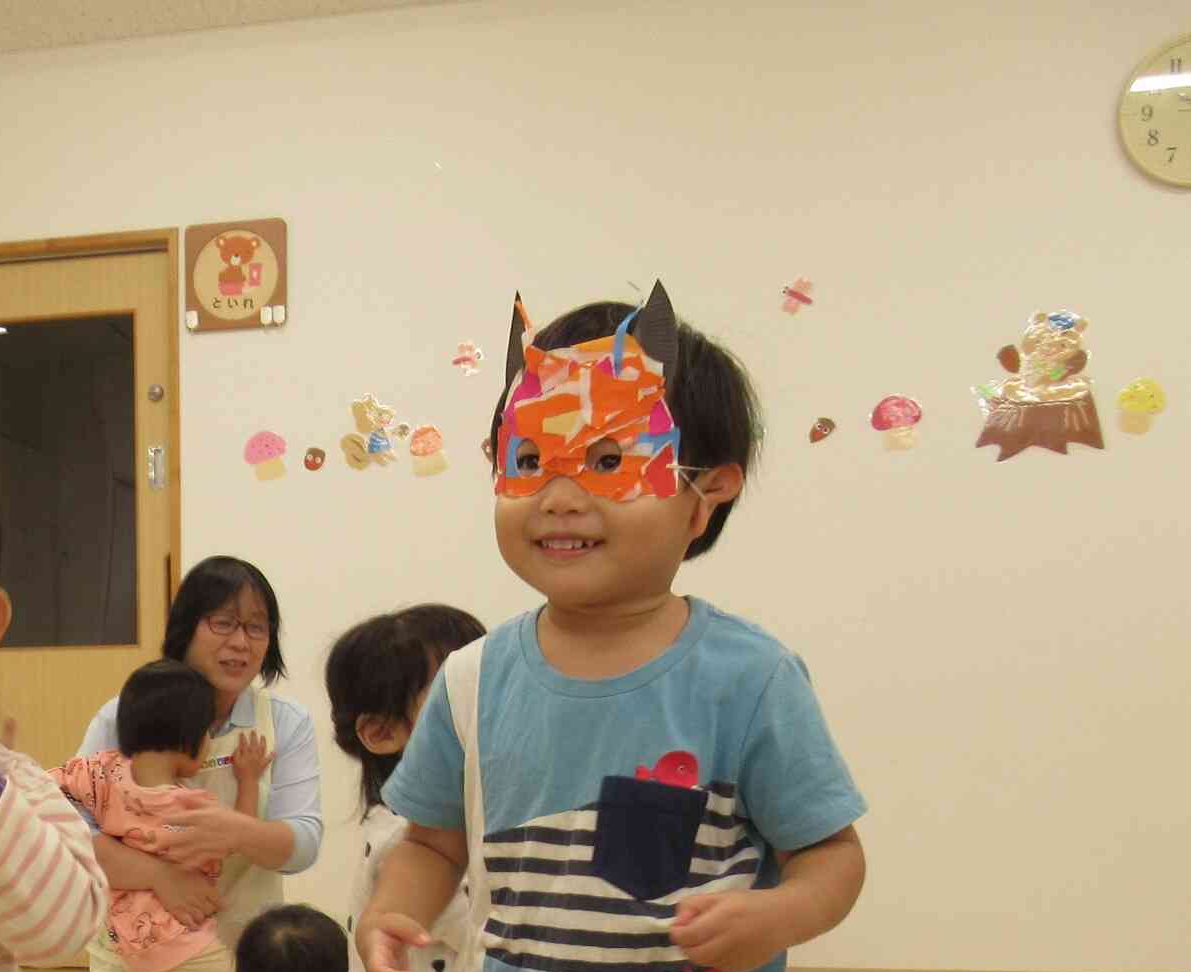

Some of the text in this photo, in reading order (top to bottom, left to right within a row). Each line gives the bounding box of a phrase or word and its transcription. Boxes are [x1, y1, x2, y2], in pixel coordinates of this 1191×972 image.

[1141, 104, 1154, 122] 9
[1147, 129, 1159, 146] 8
[1166, 146, 1177, 163] 7
[212, 297, 254, 309] といれ
